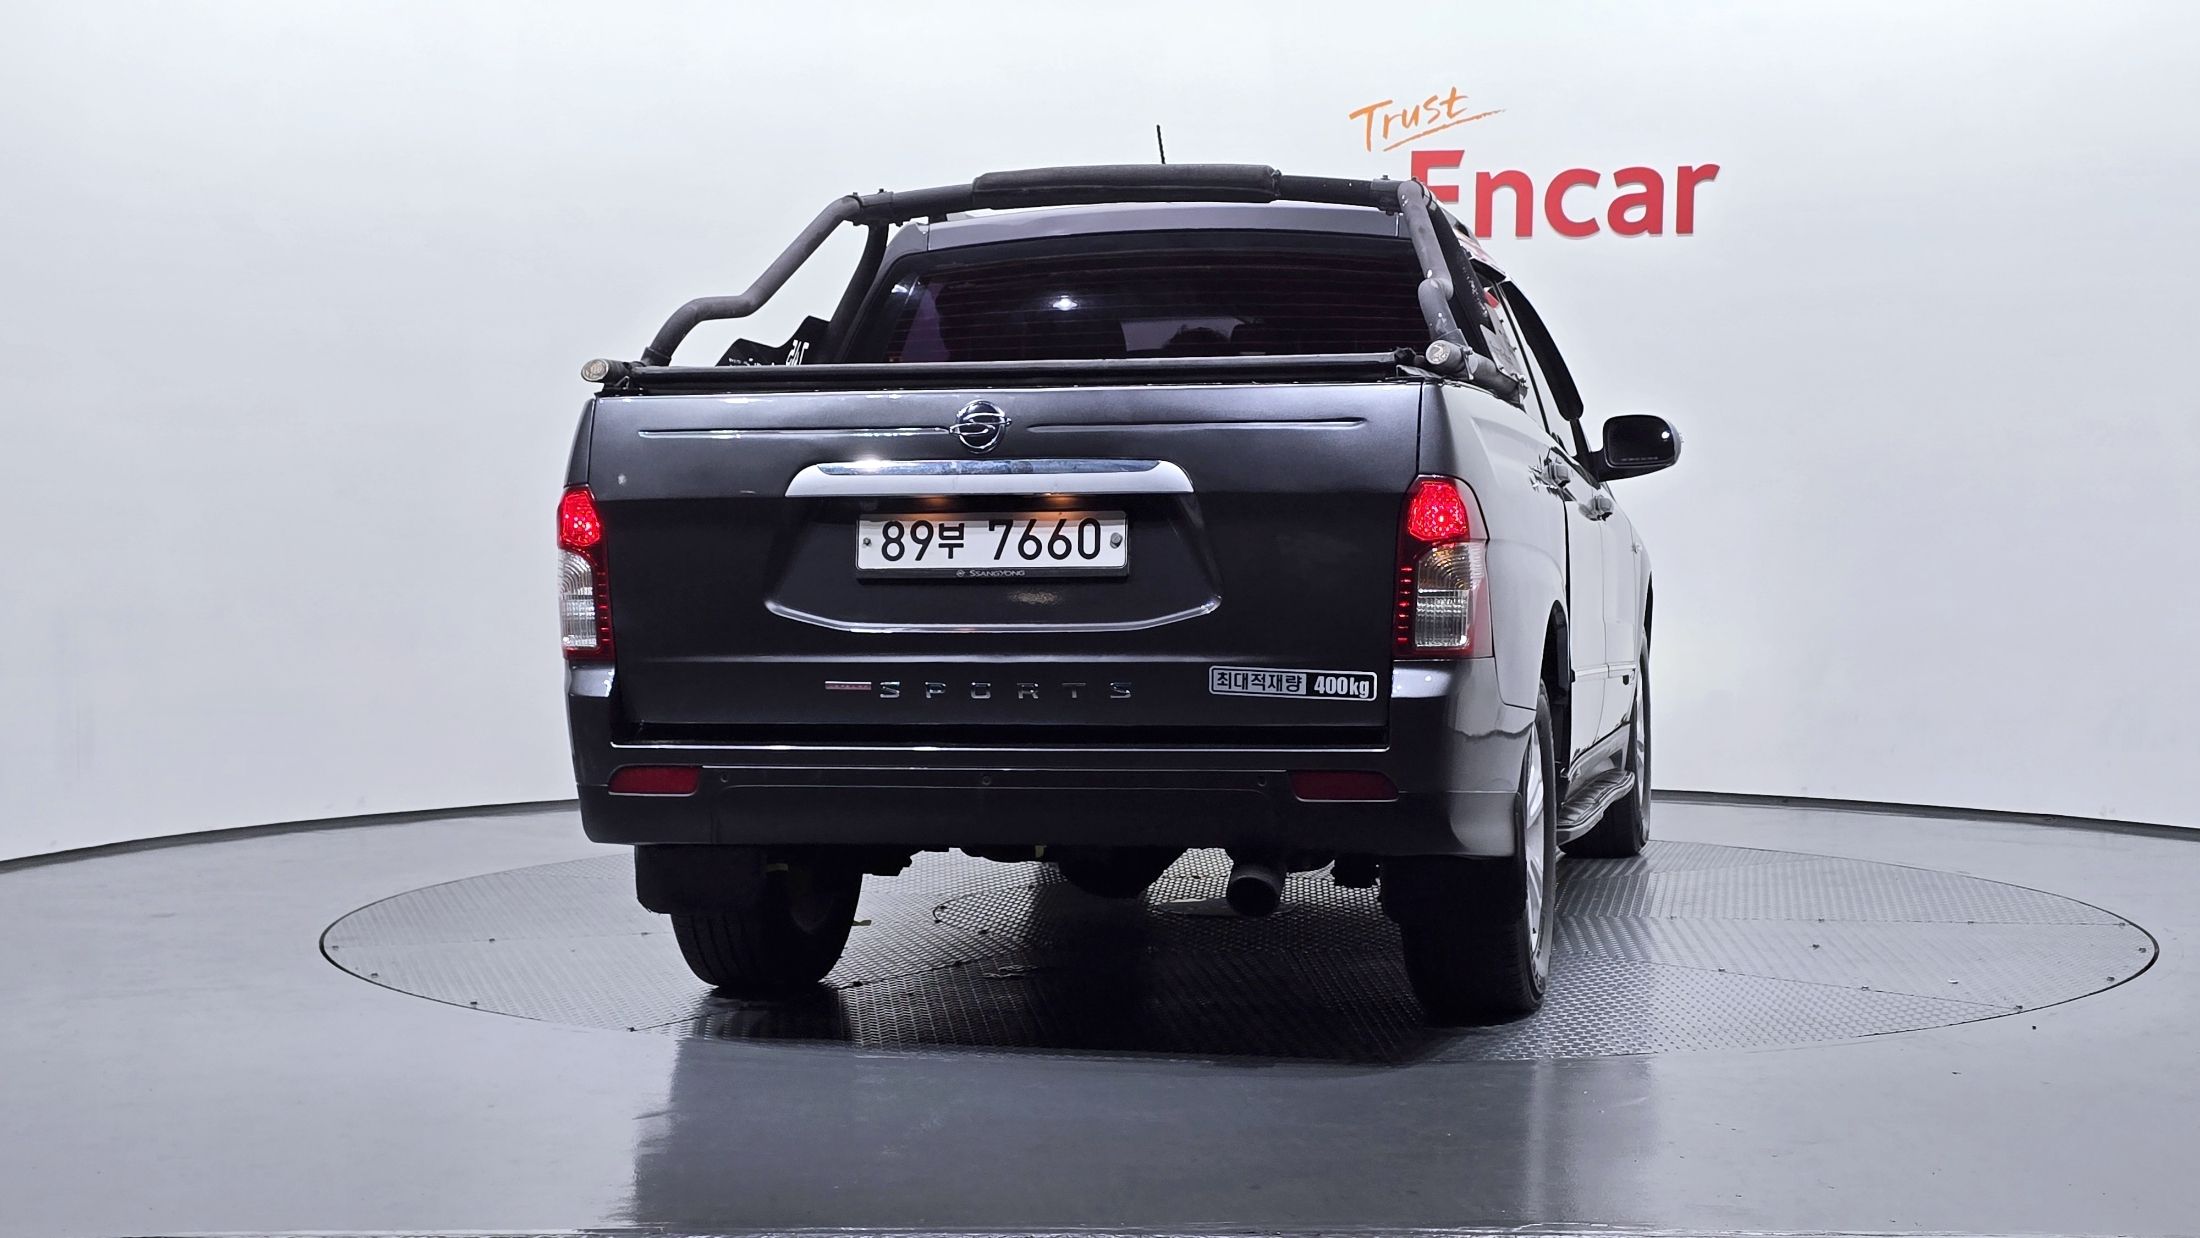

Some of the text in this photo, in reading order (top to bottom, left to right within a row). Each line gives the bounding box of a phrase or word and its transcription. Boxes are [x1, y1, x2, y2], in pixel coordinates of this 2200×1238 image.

[1349, 86, 1470, 152] Trust
[881, 517, 1102, 561] 89부 7660
[969, 569, 1025, 577] SSANGYONG
[879, 681, 1132, 699] SPORTS
[1217, 671, 1303, 693] 최대적재량
